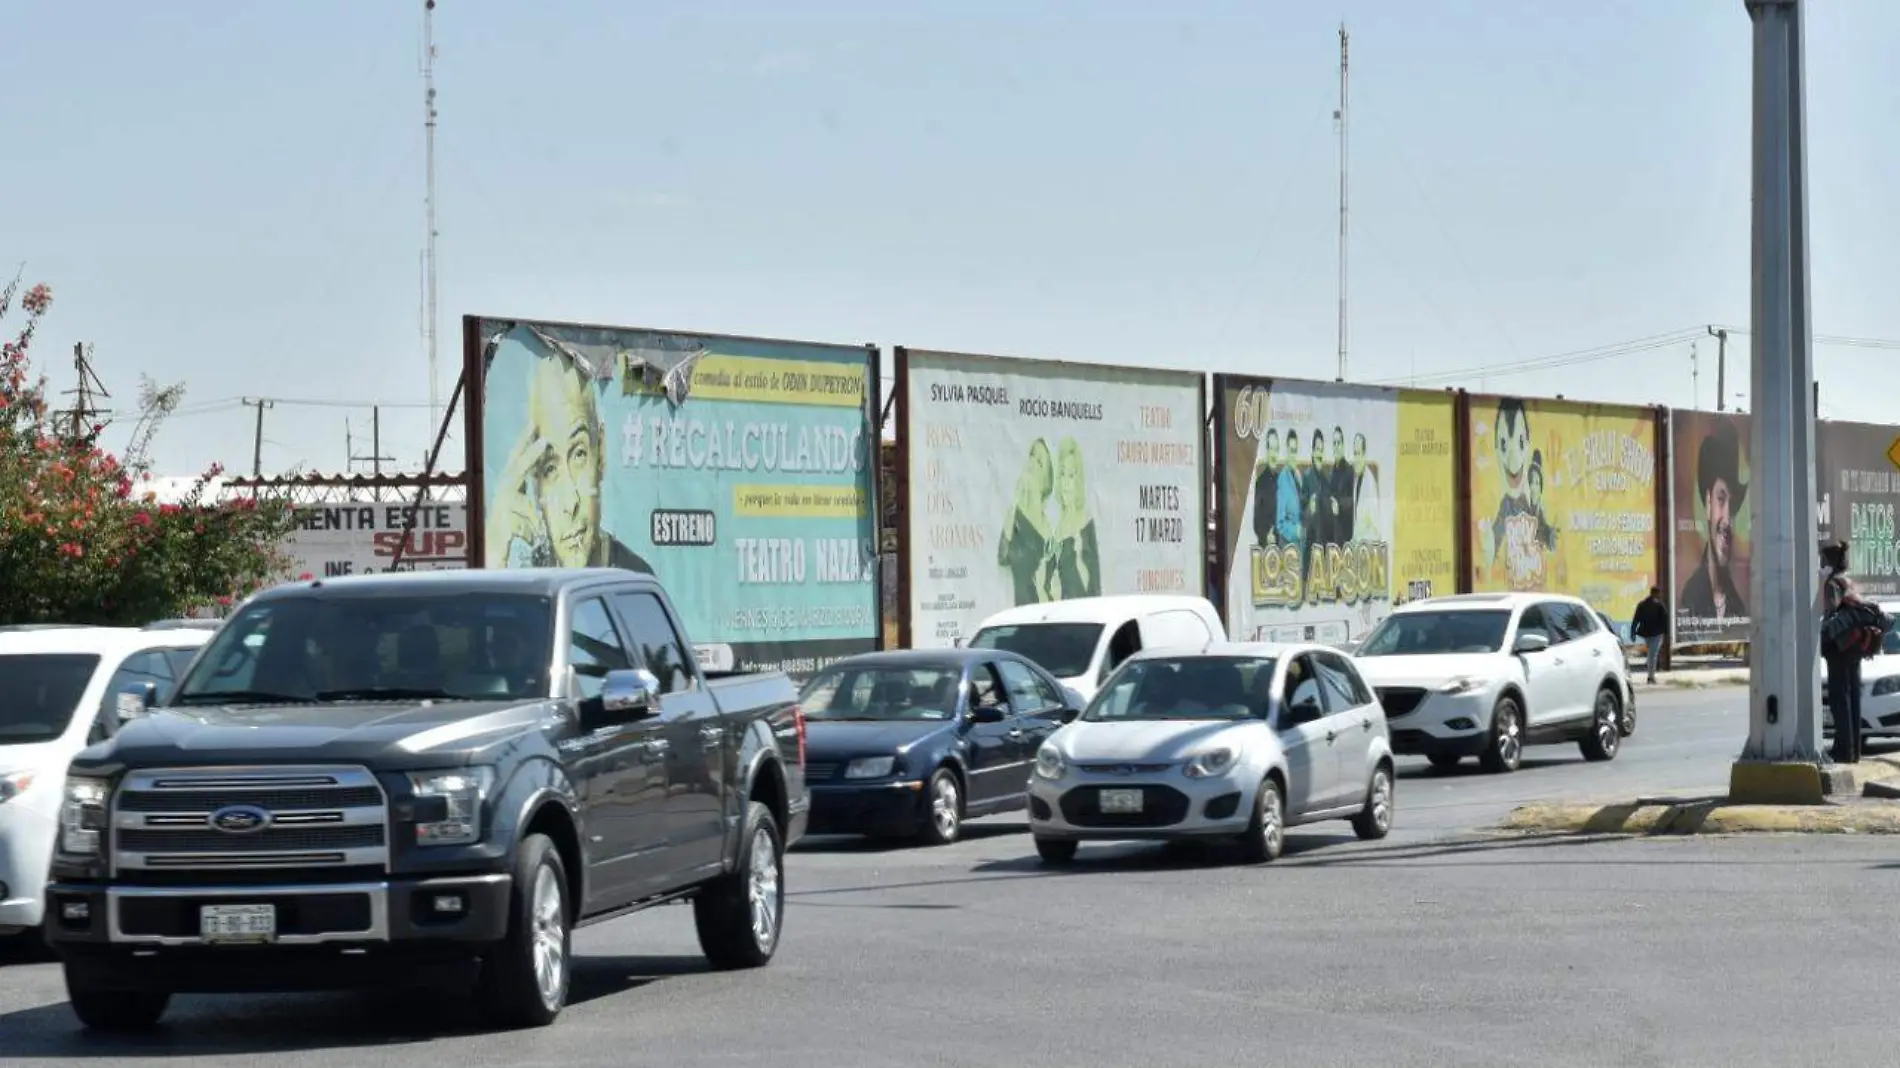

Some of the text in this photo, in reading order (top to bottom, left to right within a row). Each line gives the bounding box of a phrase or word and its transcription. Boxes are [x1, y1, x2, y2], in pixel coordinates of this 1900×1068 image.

[931, 383, 1010, 405] SYLVIA PASQUEL
[1019, 397, 1103, 420] ROCÍO BANQUELLS
[1140, 406, 1173, 428] TEATRO
[1139, 484, 1180, 511] MARTES
[386, 506, 450, 528] ESTE
[653, 511, 714, 543] ESTRENO
[1135, 517, 1183, 543] 17 MARZO
[1851, 502, 1895, 539] DATOS
[735, 538, 806, 583] TEATRO
[1137, 569, 1185, 592] FUNCIONES
[1250, 540, 1389, 608] LOS APSON
